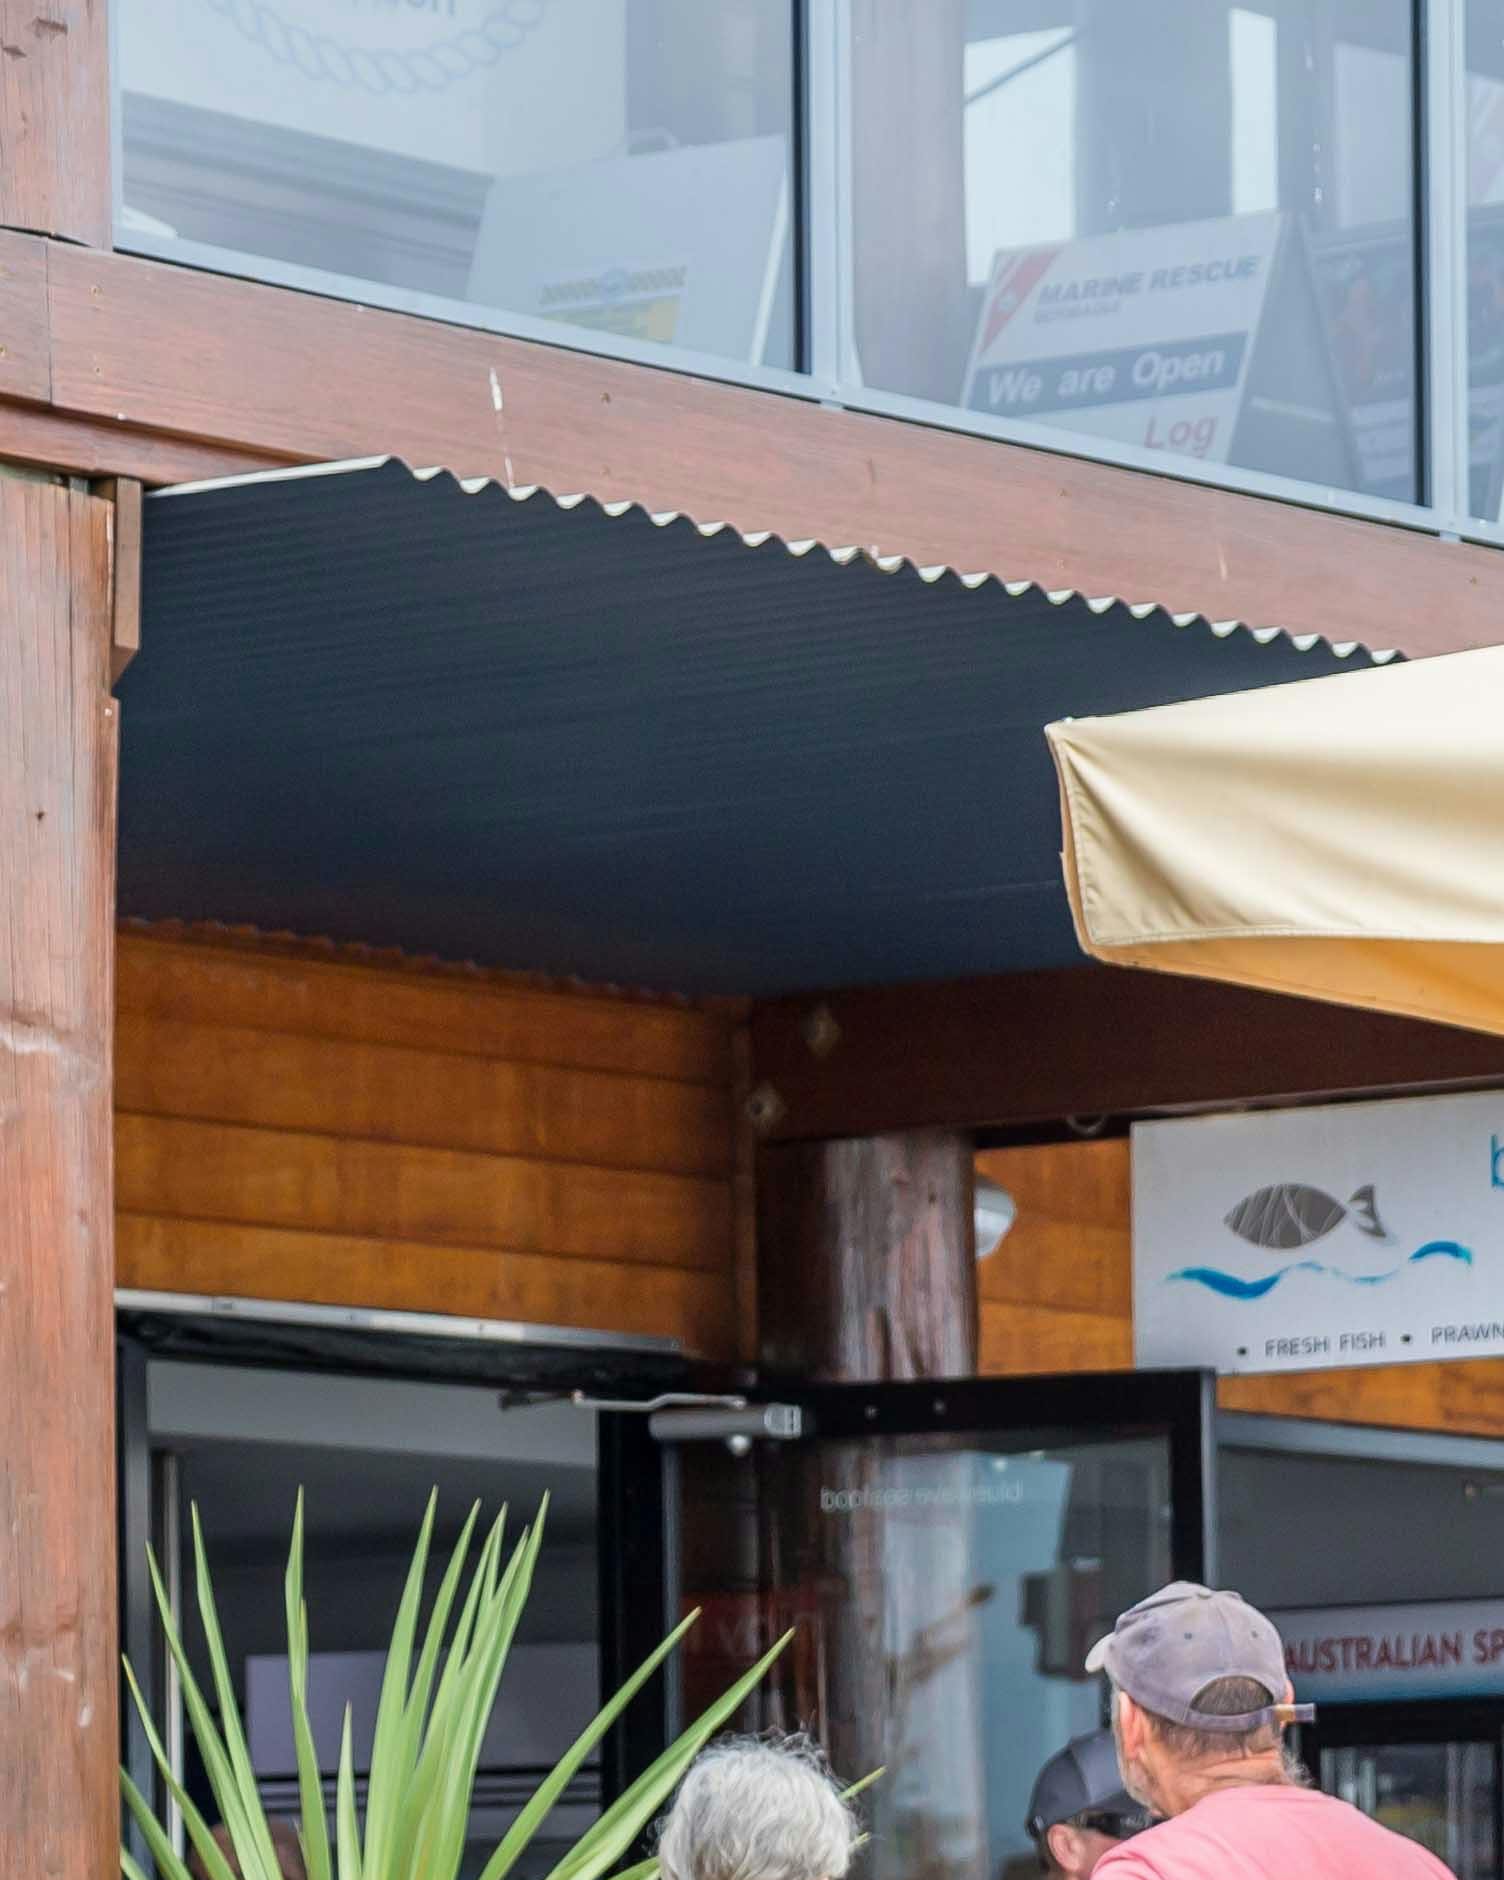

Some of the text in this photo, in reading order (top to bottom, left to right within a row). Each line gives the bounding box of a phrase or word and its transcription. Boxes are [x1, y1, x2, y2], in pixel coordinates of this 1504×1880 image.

[1039, 255, 1259, 303] MARINE RESCUE
[988, 350, 1225, 405] We are Open
[1143, 415, 1219, 460] Log
[1263, 1334, 1329, 1358] FRESH
[1338, 1330, 1387, 1352] FISH
[1283, 1628, 1462, 1674] AUSTRALIAN
